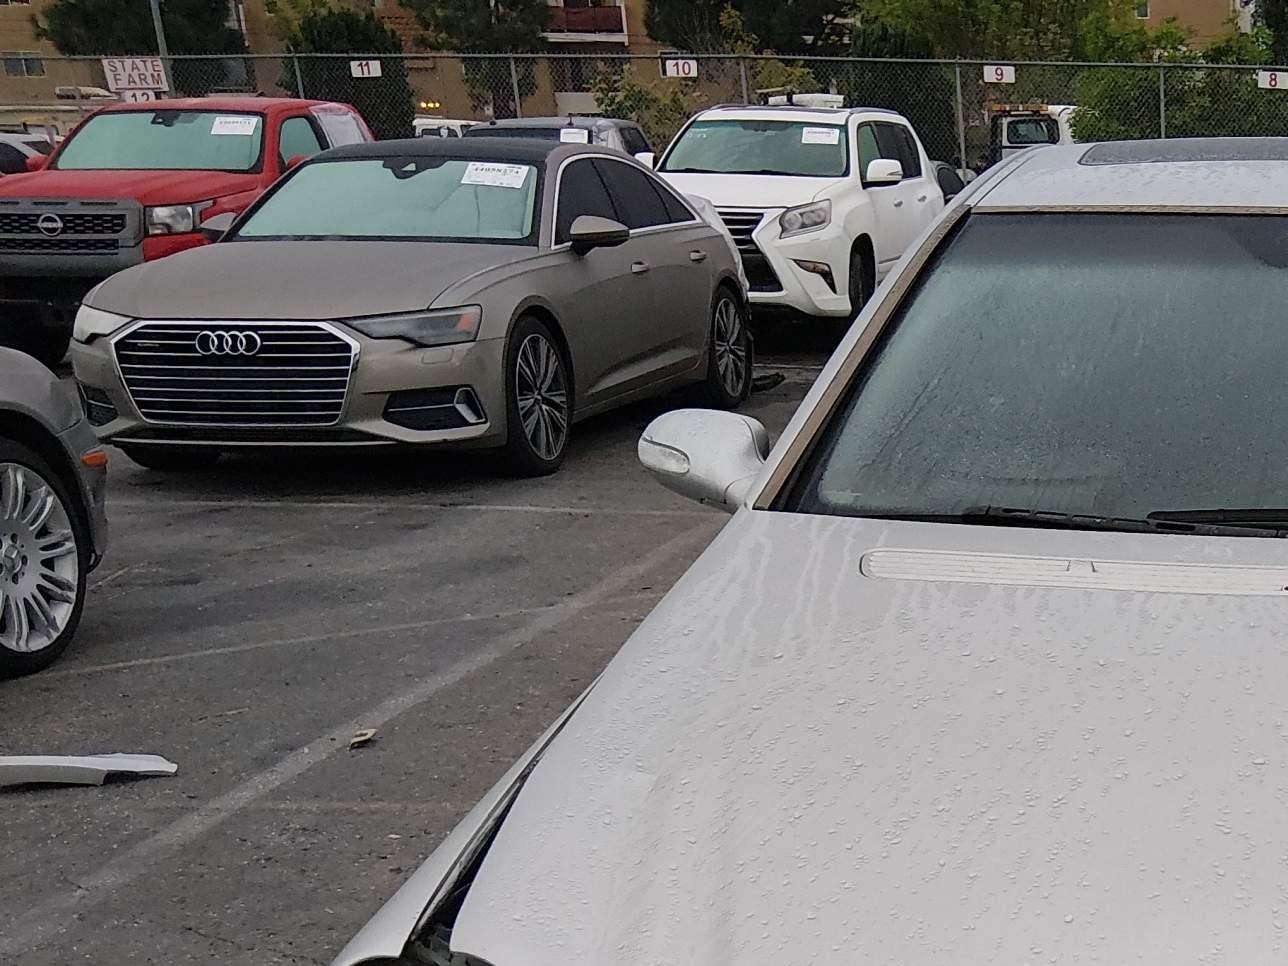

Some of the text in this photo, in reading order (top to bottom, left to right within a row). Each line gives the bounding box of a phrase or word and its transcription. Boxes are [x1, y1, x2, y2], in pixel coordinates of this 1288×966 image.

[107, 59, 162, 73] STATE
[357, 61, 371, 76] 11
[673, 61, 692, 76] 10
[112, 73, 163, 86] FARM
[994, 67, 1004, 81] 9
[1268, 73, 1278, 87] 8
